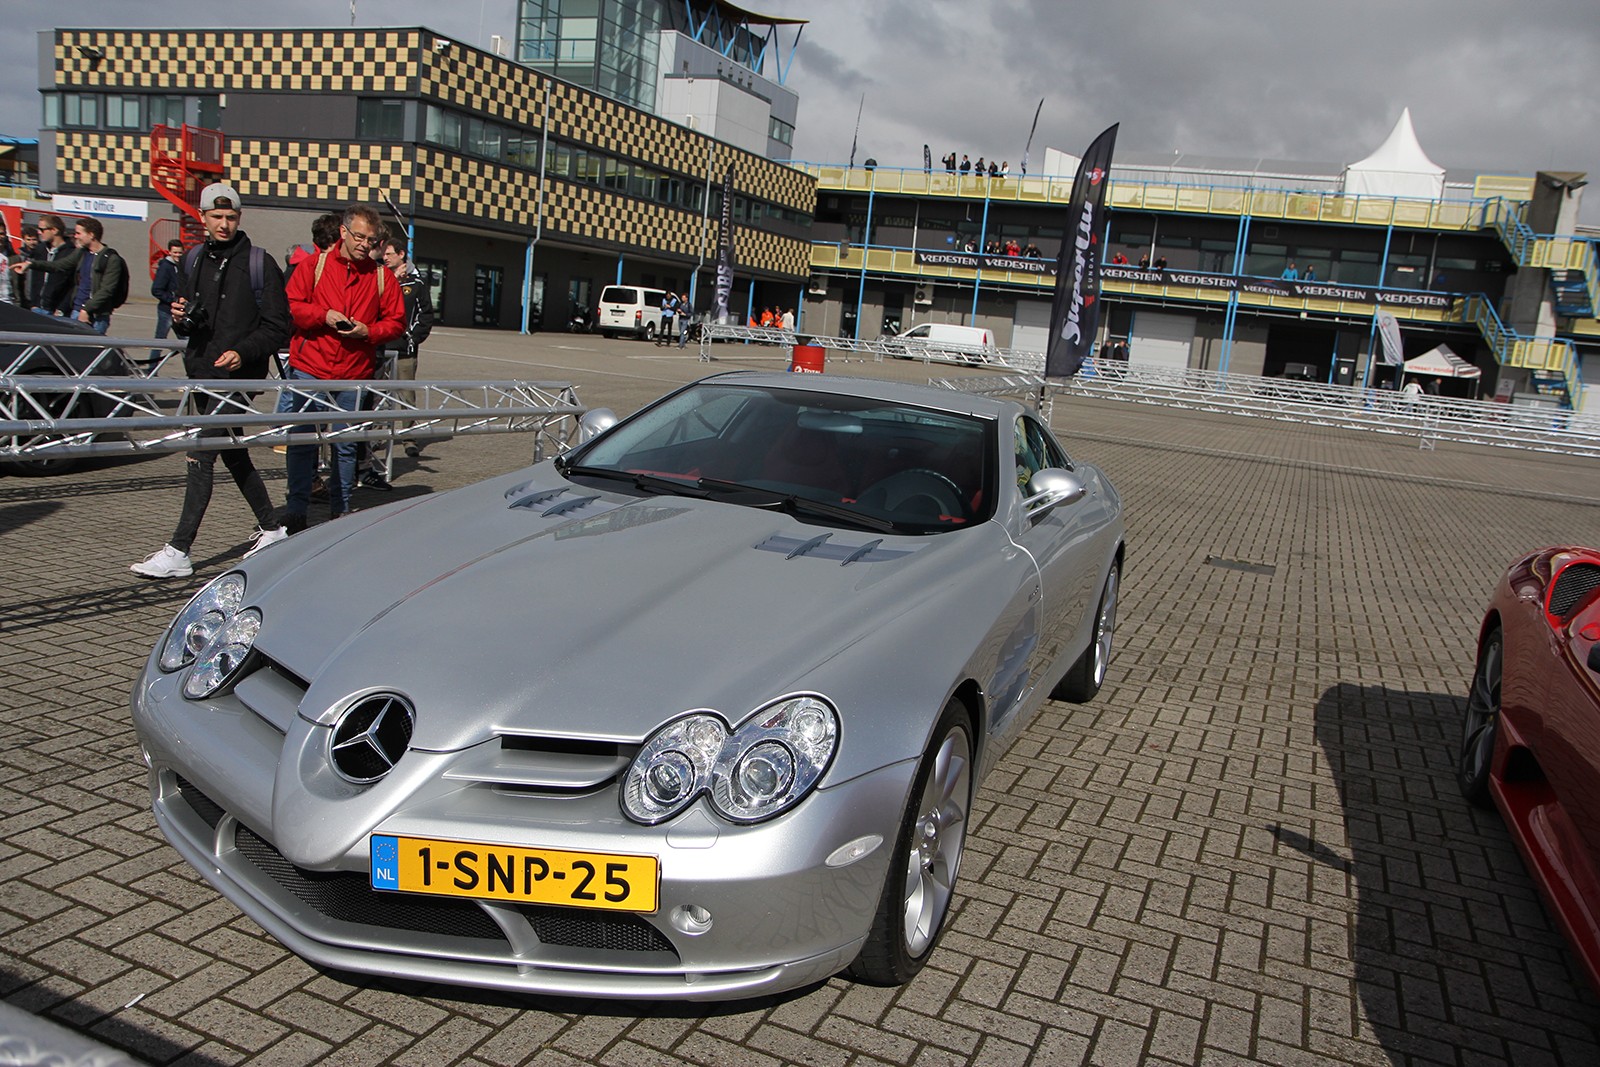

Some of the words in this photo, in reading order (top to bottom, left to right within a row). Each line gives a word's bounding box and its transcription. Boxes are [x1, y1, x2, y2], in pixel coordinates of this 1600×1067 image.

[93, 200, 114, 212] Office
[920, 254, 978, 266] VREDESTEIN
[985, 259, 1046, 272] VREDESTEIN
[1100, 269, 1162, 282] VREDESTEIN
[1170, 275, 1237, 287] VREDESTEIN
[717, 265, 733, 309] CARS
[1243, 285, 1290, 297] VREDESTEIN
[1295, 285, 1366, 300] VREDESTEIN
[1375, 293, 1449, 306] VREDESTEIN
[377, 867, 395, 881] NL
[418, 847, 630, 902] 1-SNP-25
